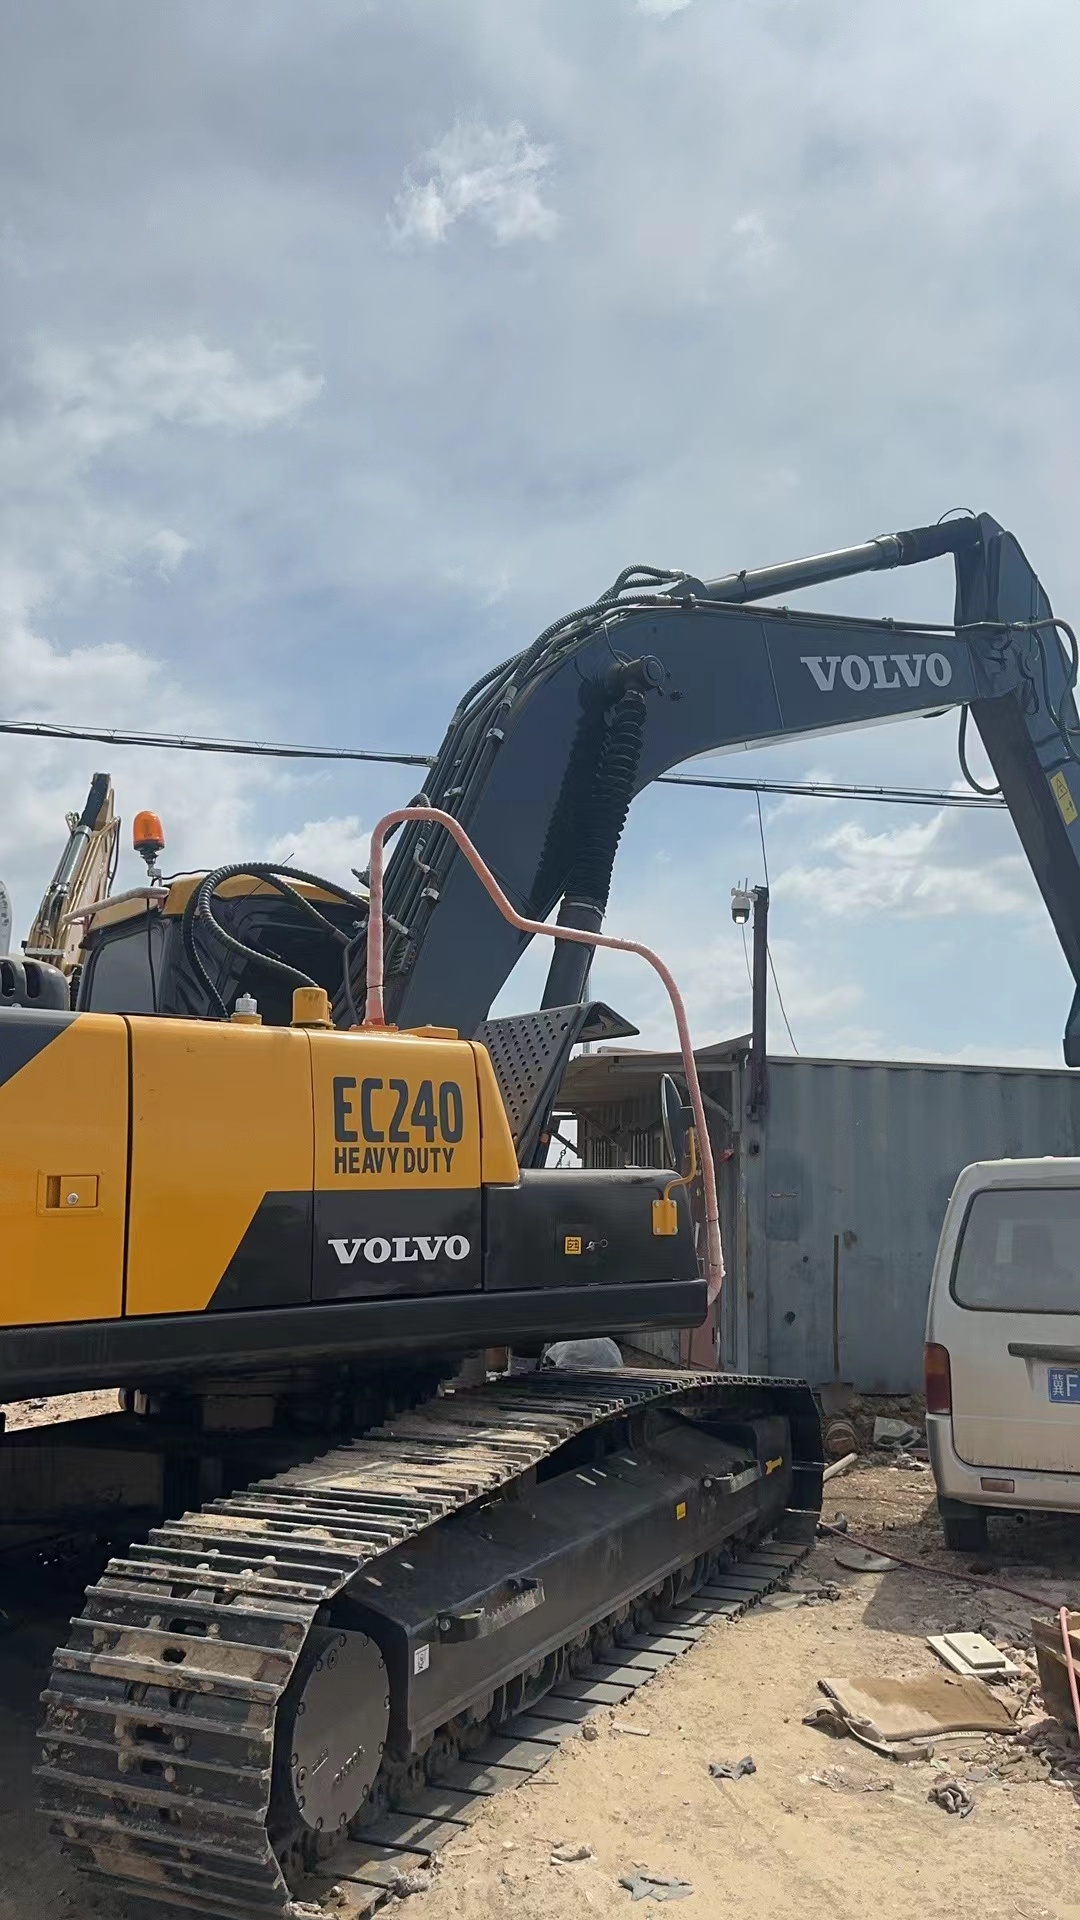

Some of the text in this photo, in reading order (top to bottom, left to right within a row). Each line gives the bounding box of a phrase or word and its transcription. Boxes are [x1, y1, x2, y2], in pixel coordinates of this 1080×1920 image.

[800, 652, 952, 692] VOLVO
[333, 1077, 463, 1144] EC240
[334, 1147, 455, 1174] HEAVY DUTY
[328, 1234, 471, 1264] VOLVO
